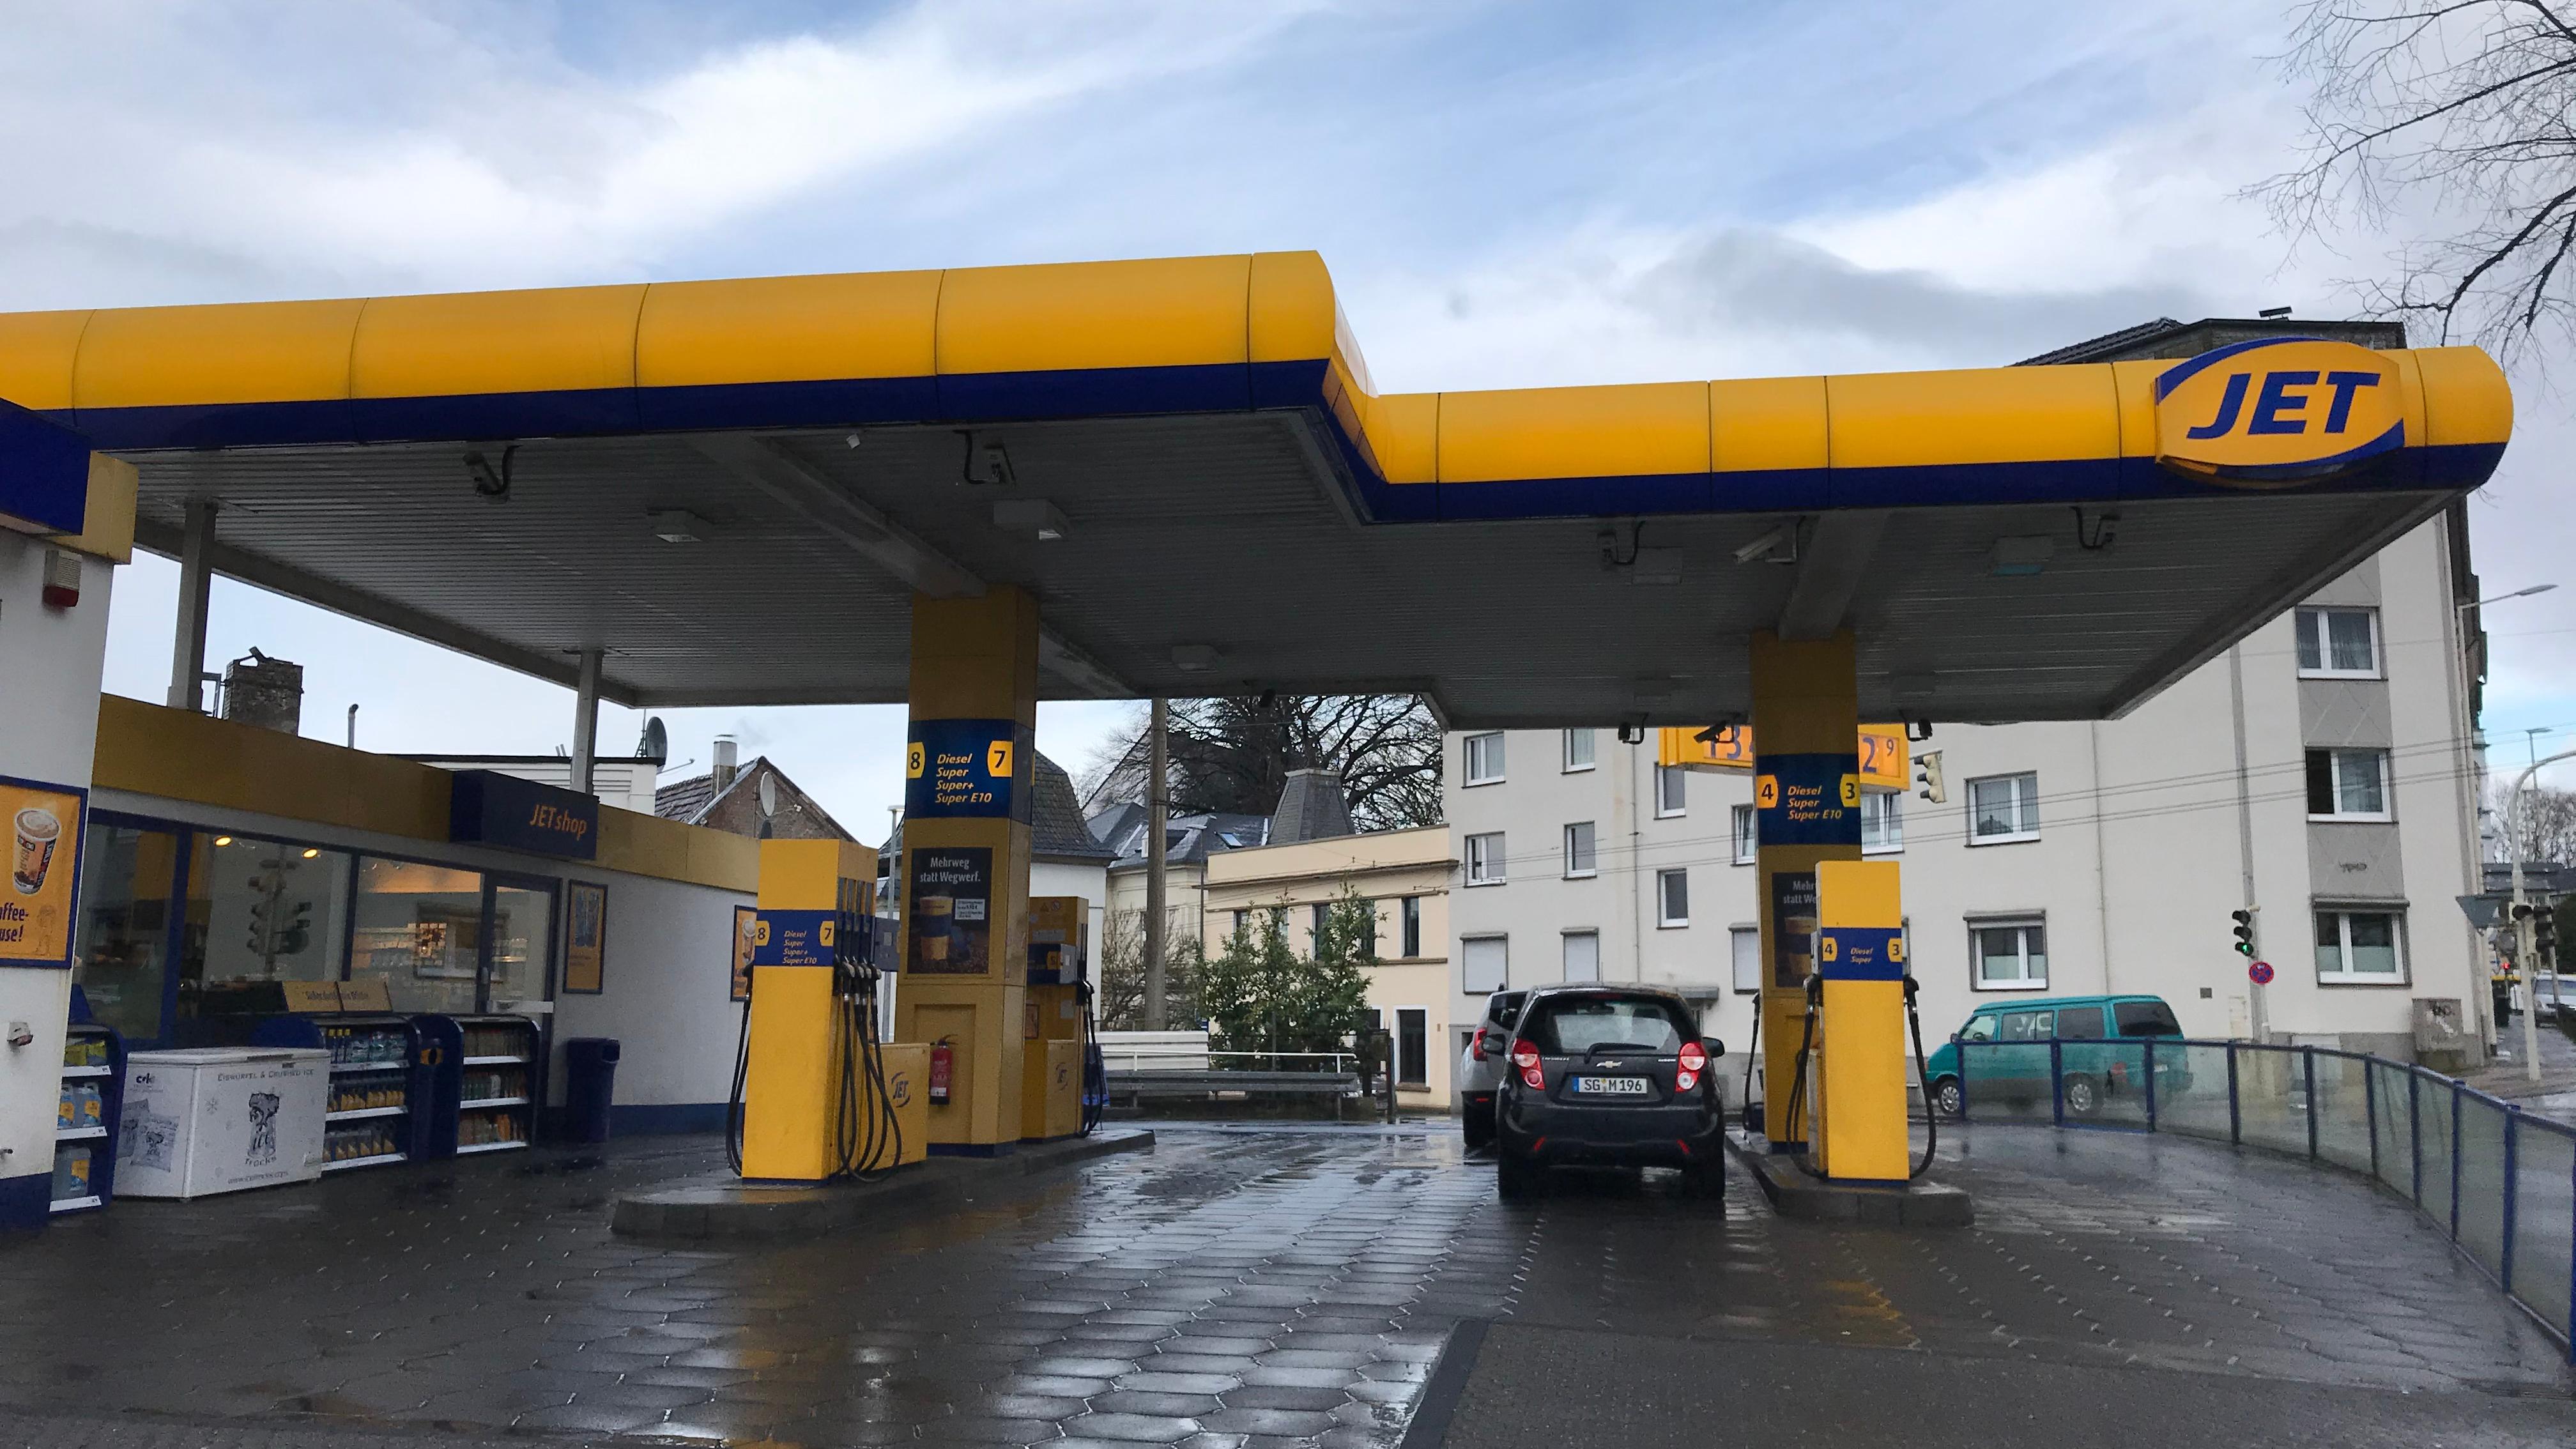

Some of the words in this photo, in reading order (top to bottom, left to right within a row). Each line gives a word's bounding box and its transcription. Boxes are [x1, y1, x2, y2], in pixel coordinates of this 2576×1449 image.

[2187, 371, 2381, 440] JET
[910, 751, 921, 770] 8
[937, 753, 973, 765] Diesel
[993, 750, 1006, 769] 7
[936, 767, 969, 779] Super
[935, 779, 974, 792] Super+
[1788, 785, 1821, 795] Diesel
[1846, 783, 1855, 799] 3
[1761, 783, 1774, 801] 4
[935, 793, 968, 805] Super
[970, 792, 992, 803] E10
[1788, 798, 1820, 808] Super
[1788, 810, 1820, 820] Super
[1822, 809, 1841, 819] E10
[930, 857, 970, 870] Mehrweg
[920, 872, 938, 882] statt
[940, 871, 981, 884] Wegwerf.
[1793, 880, 1816, 891] Mehr
[1784, 894, 1802, 904] statt
[758, 927, 765, 940] 8
[825, 928, 832, 940] 7
[783, 939, 805, 948] Super
[1825, 944, 1833, 955] 4
[1850, 947, 1874, 955] Diesel
[1892, 944, 1899, 956] 3
[782, 957, 804, 965] Super
[1850, 956, 1871, 965] Super
[1584, 1079, 1600, 1091] SG
